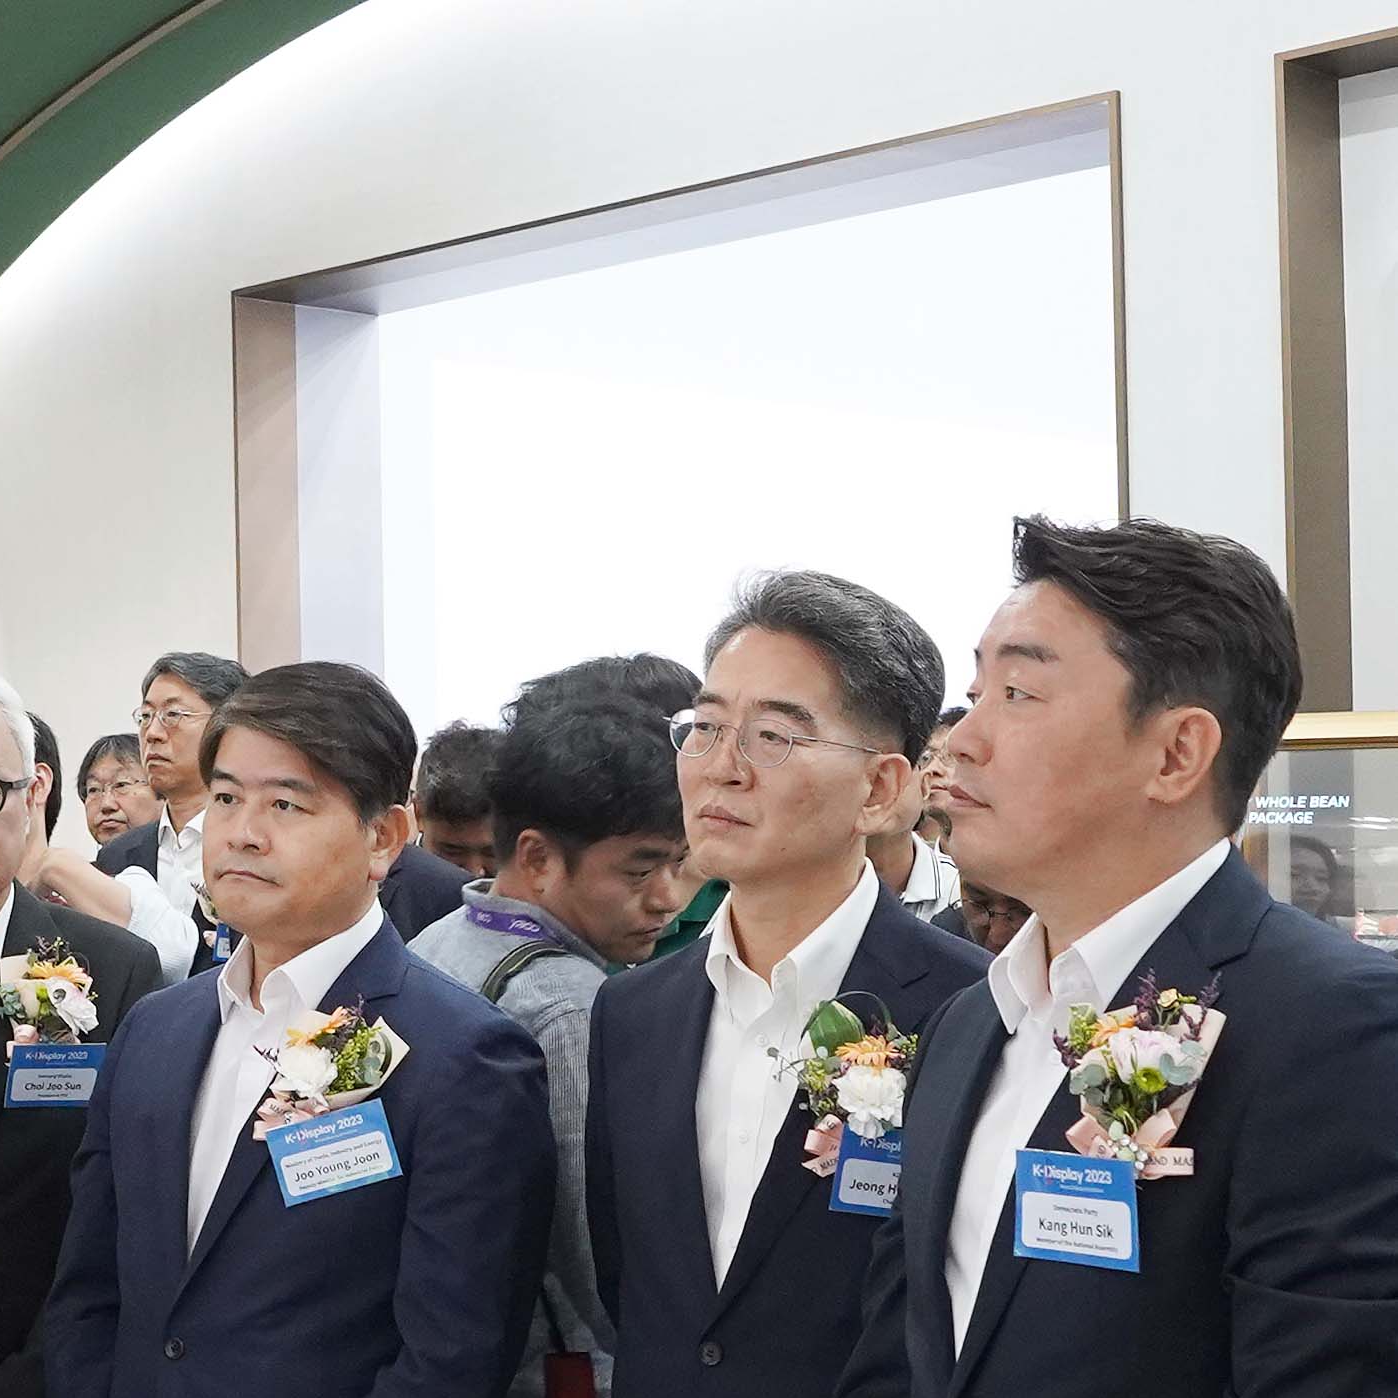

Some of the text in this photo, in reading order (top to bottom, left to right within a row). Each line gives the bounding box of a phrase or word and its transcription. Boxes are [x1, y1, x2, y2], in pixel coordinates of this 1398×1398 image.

[1255, 795, 1350, 809] WHOLE BEAN
[1248, 811, 1314, 825] PACKAGE
[285, 1123, 336, 1145] K-Display
[337, 1114, 364, 1130] 2023
[860, 1136, 901, 1153] K-Displ
[294, 1170, 314, 1183] Joo
[315, 1160, 351, 1176] Young
[353, 1151, 381, 1167] Joon
[1032, 1164, 1113, 1184] K-Display 2023
[849, 1179, 898, 1195] Jeong H
[1038, 1218, 1115, 1239] Kang Hun Sik
